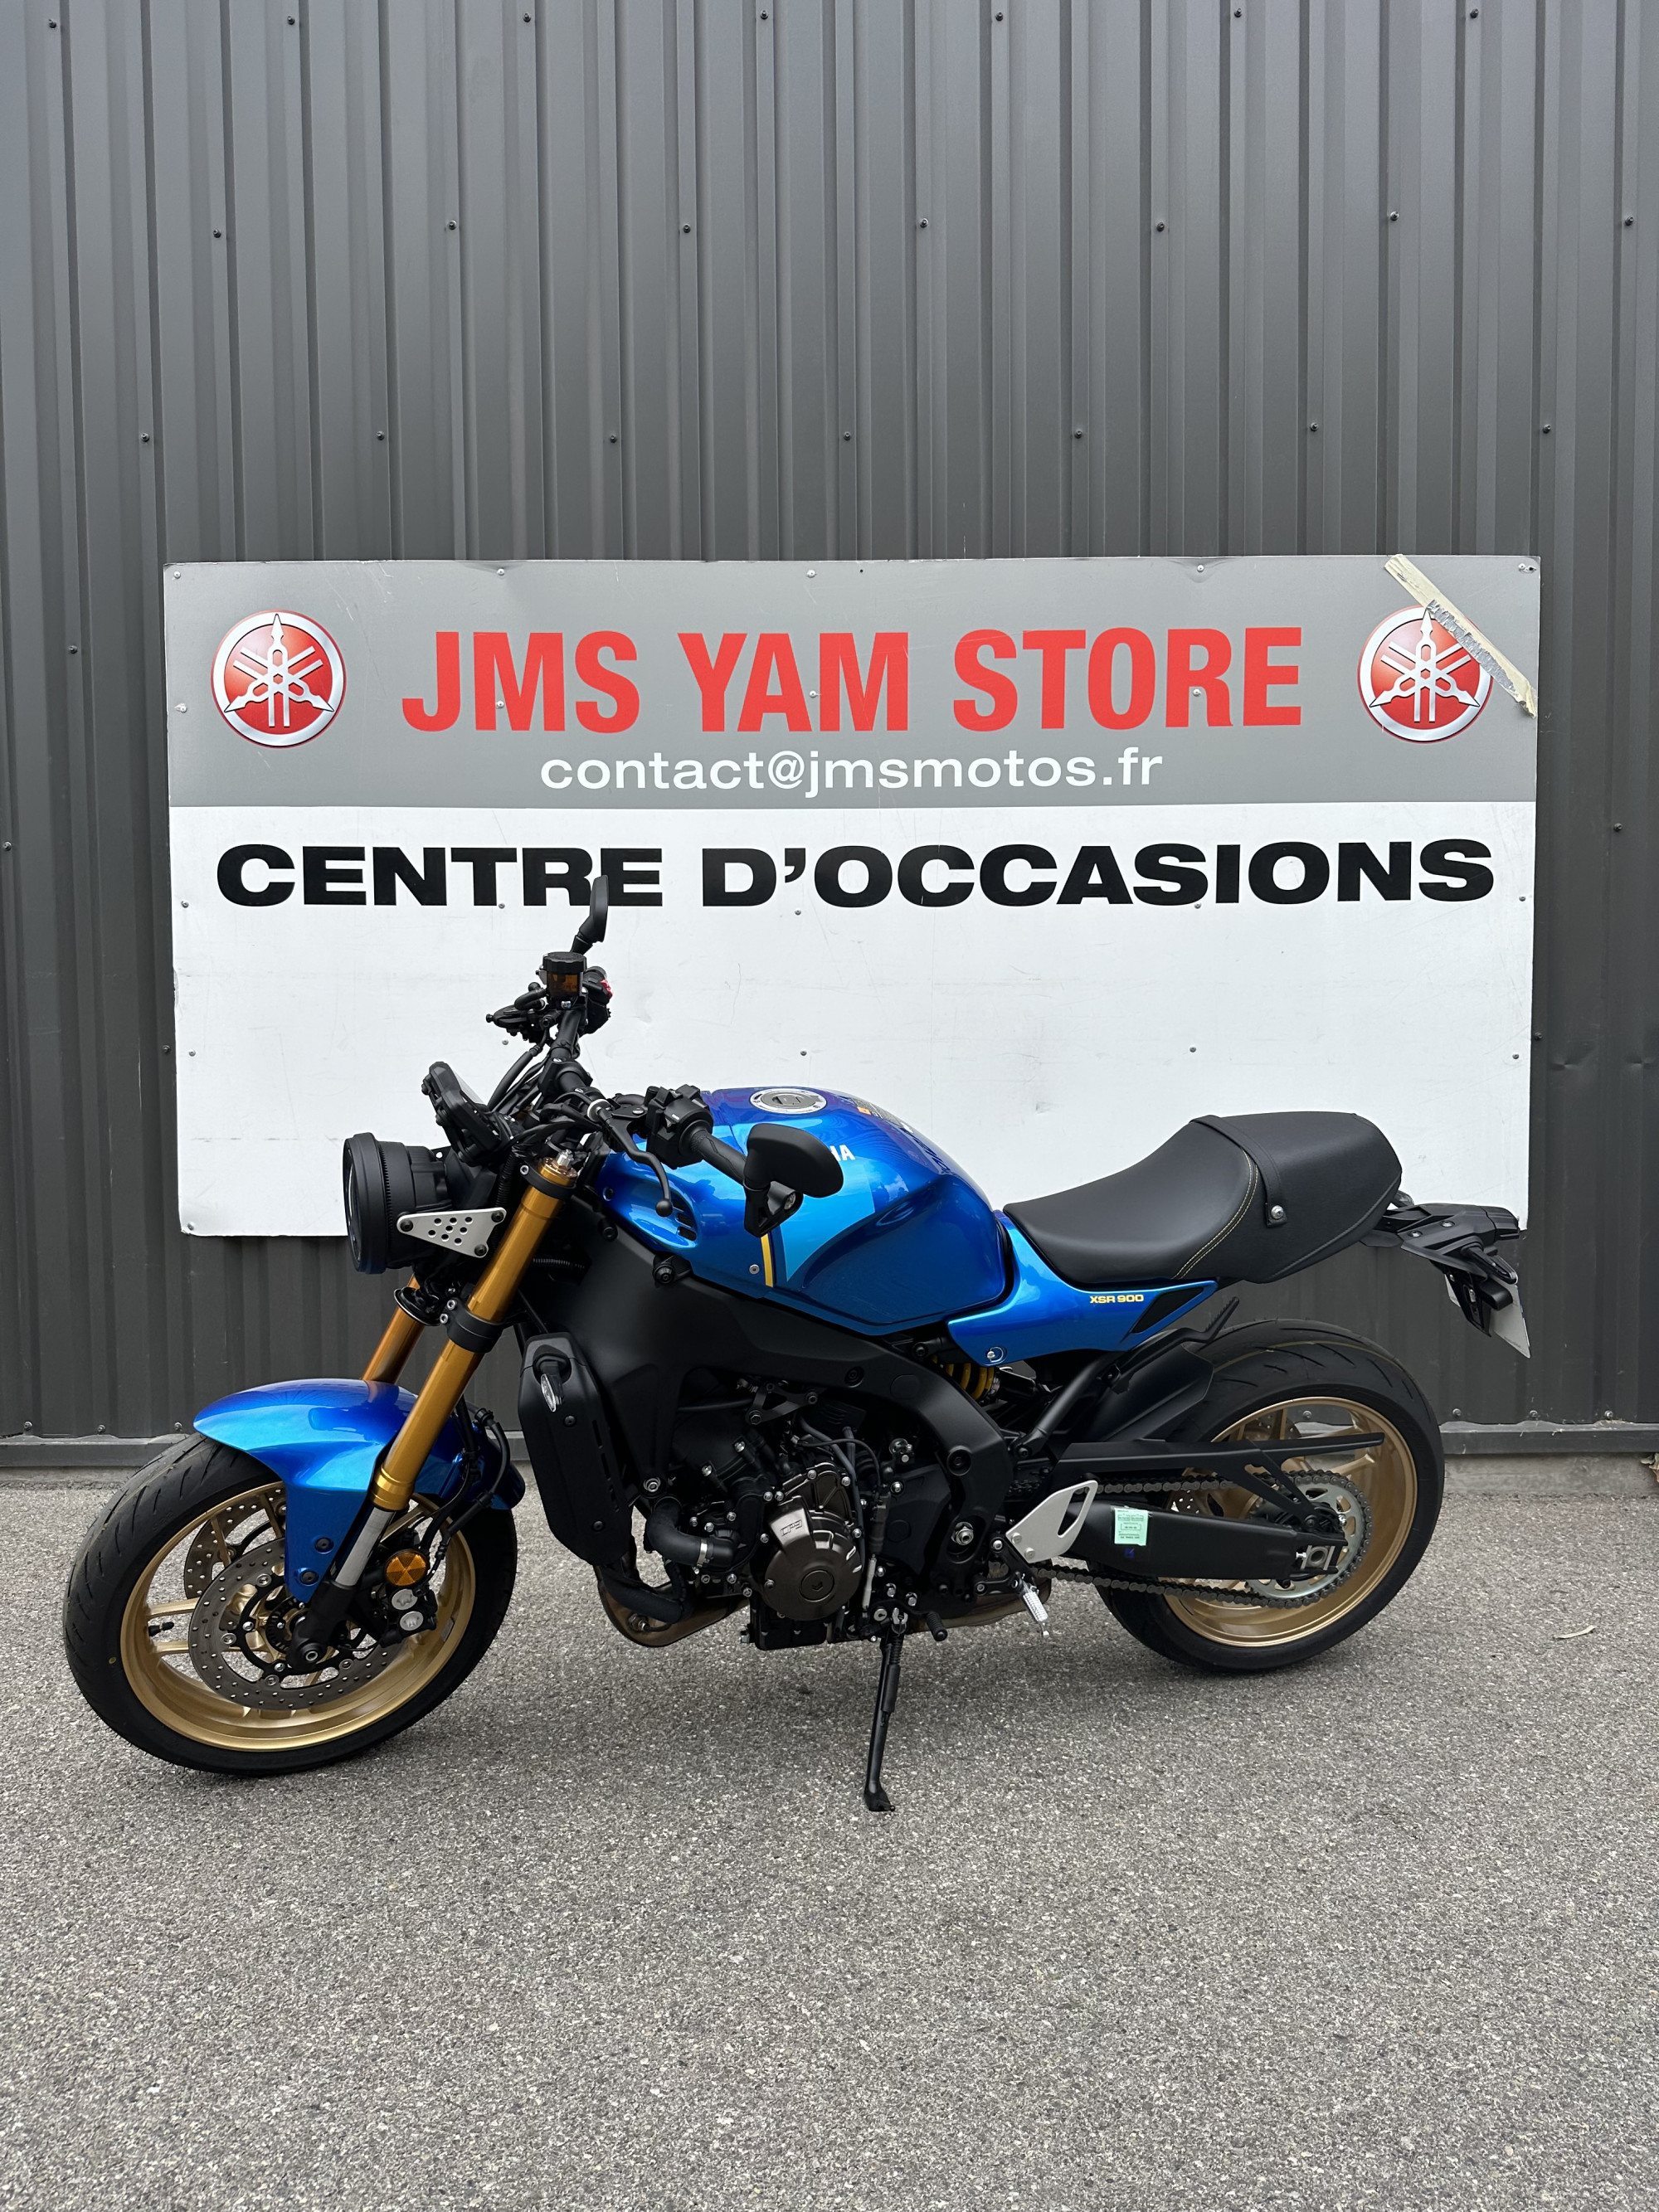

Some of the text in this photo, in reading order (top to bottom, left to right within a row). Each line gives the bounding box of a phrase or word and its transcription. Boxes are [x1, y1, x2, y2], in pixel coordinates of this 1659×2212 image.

[402, 628, 1301, 733] JMS YAM STORE
[541, 746, 1163, 799] contact@jmsmotos.fr
[217, 839, 1493, 907] CENTRE D’OCCASIONS
[1090, 1294, 1144, 1304] XSR 900
